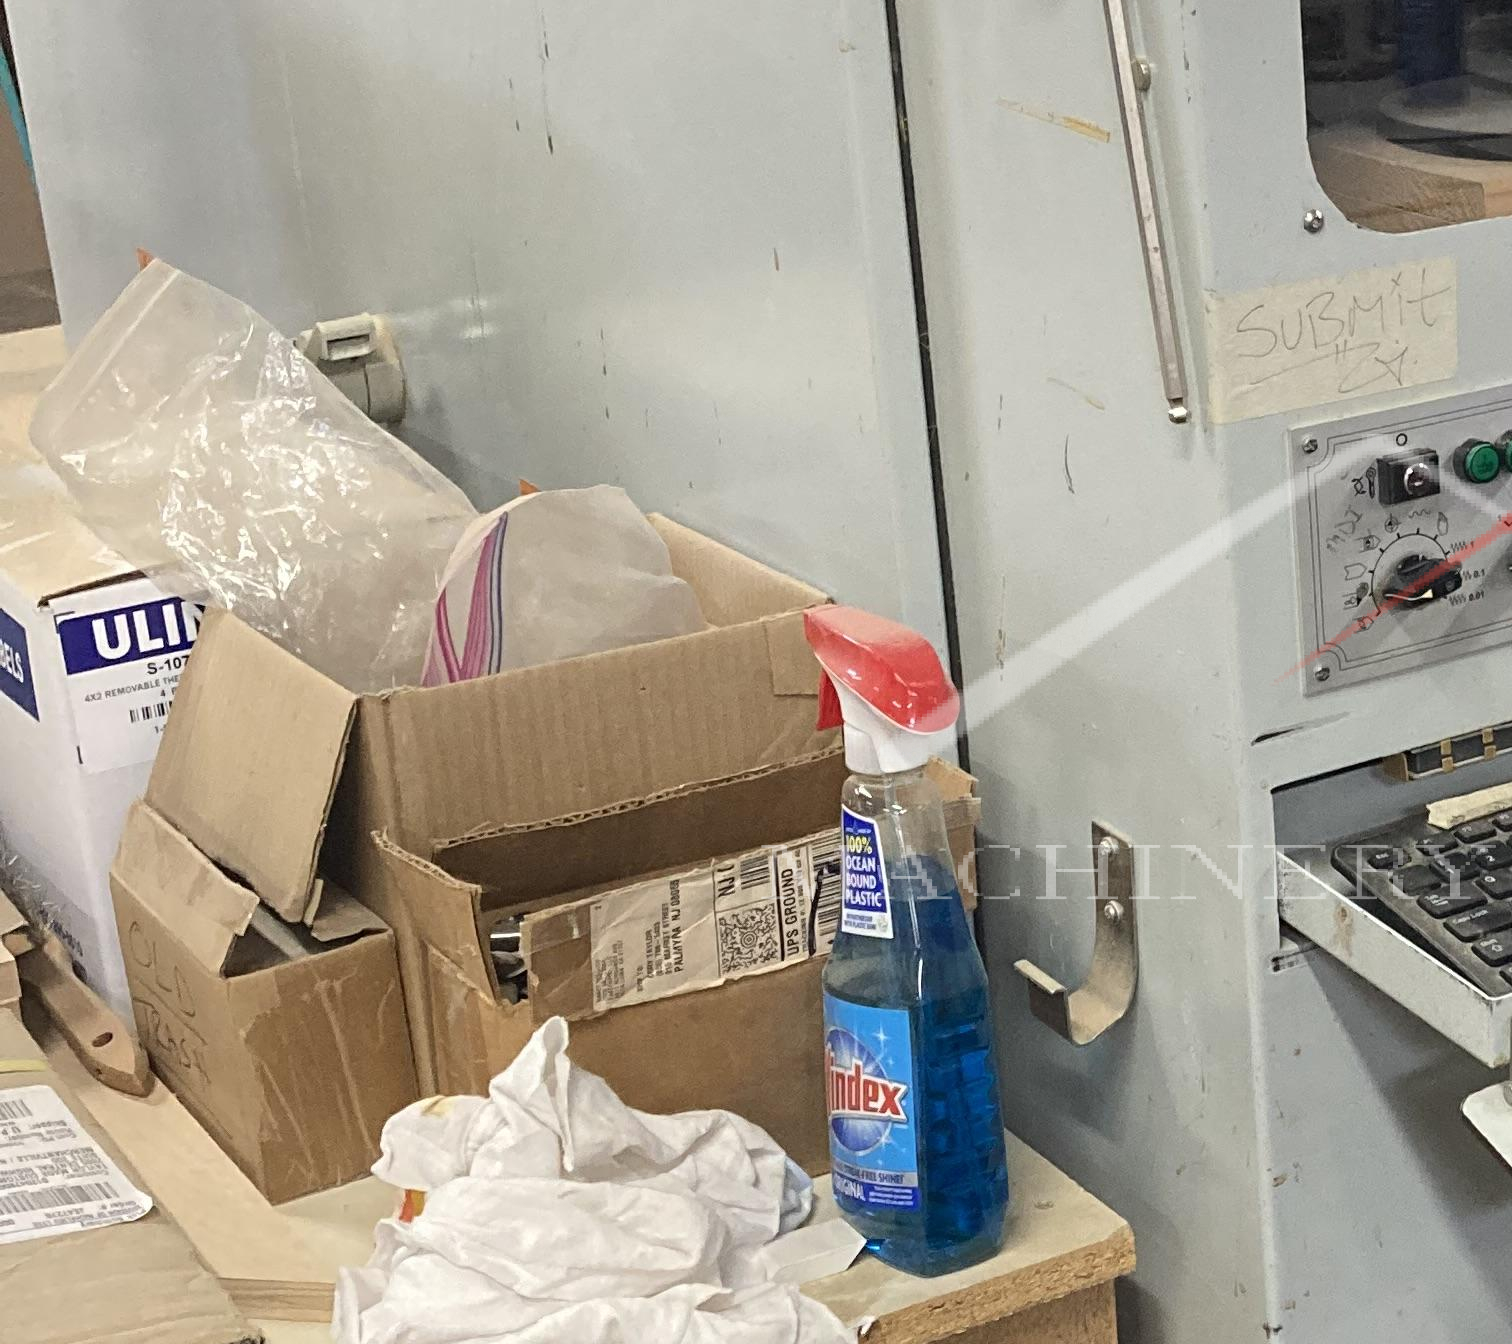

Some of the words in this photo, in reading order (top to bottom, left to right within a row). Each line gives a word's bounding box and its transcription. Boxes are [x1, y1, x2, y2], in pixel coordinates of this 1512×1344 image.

[104, 680, 160, 699] REMOVABLE
[846, 835, 873, 855] 100%
[846, 855, 876, 873] OCEAN
[718, 877, 736, 897] NJ
[846, 873, 877, 889] BOUND
[780, 868, 797, 924] GROUND
[846, 889, 882, 908] PLASTIC
[672, 926, 684, 973] PALMYRA
[785, 929, 800, 956] UPS
[825, 1044, 904, 1120] index
